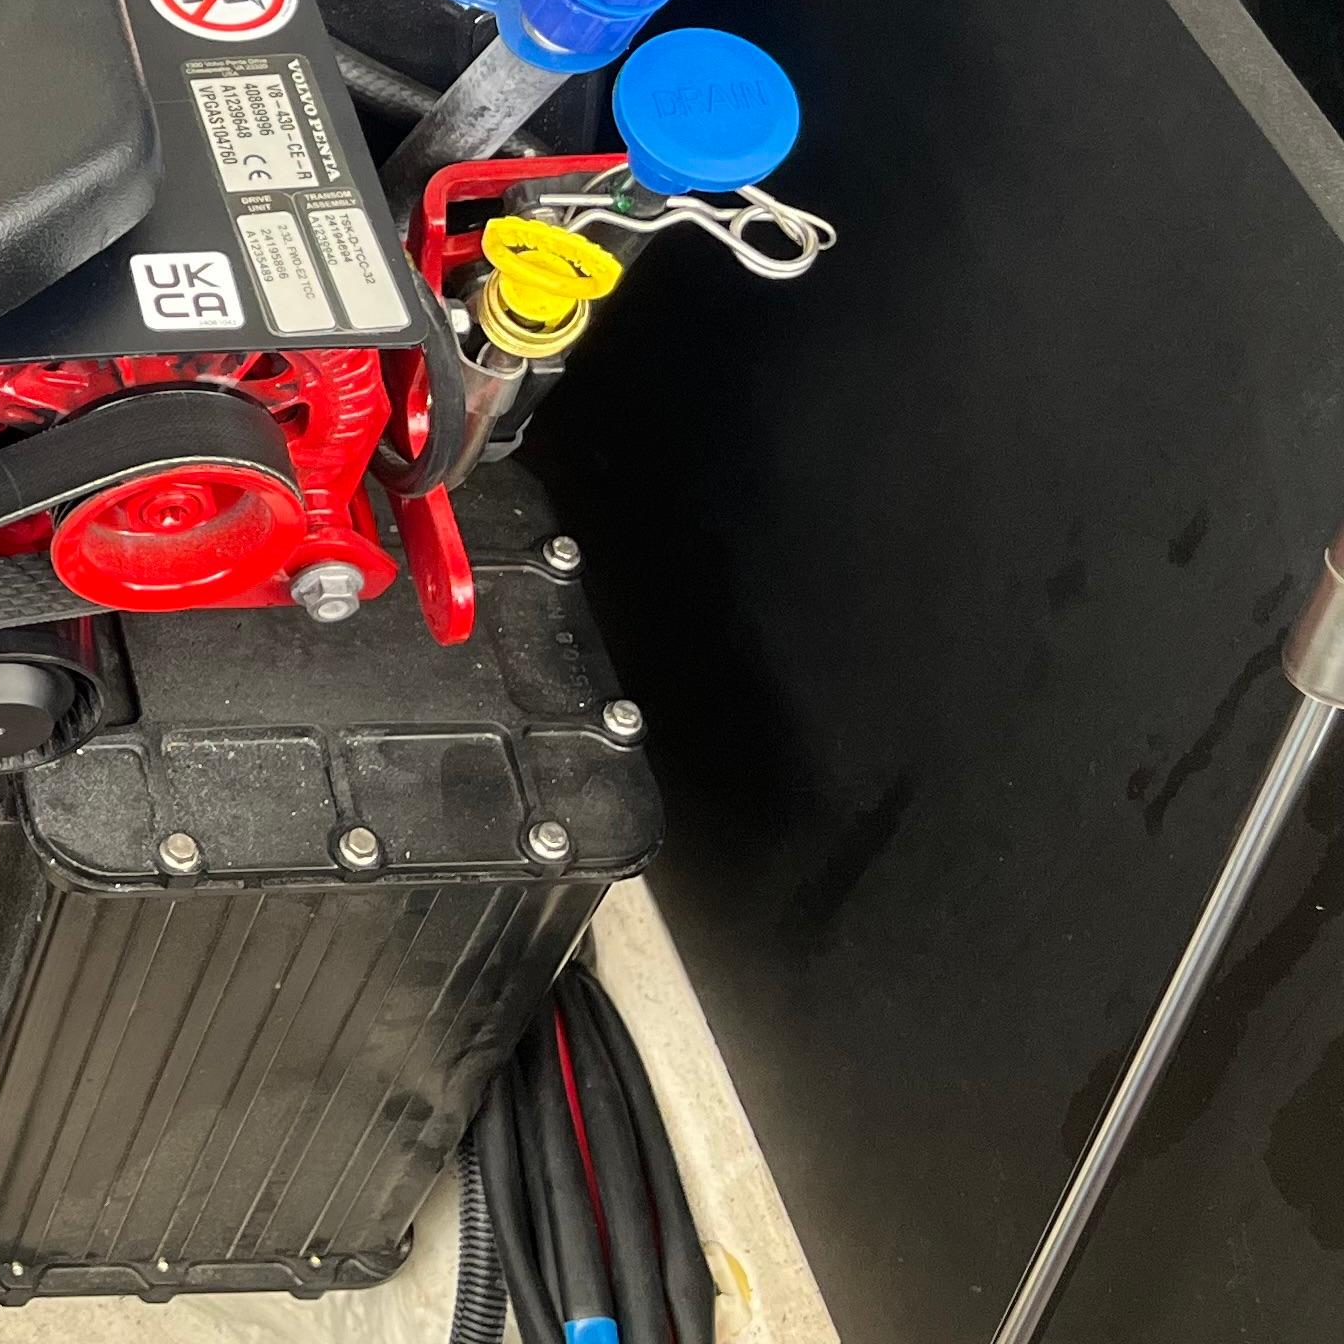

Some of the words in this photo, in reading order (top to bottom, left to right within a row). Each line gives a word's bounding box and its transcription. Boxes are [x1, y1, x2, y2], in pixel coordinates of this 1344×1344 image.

[220, 84, 253, 139] A1239648
[244, 83, 275, 137] 40869996
[652, 80, 769, 119] DRAIN
[198, 85, 239, 165] VPGAS104760
[288, 59, 317, 117] VOLVO
[308, 118, 341, 183] PENTA
[240, 195, 273, 205] DRIVE
[247, 203, 272, 213] UNIT
[304, 190, 352, 201] TRANSOM
[144, 262, 222, 288] UK
[154, 292, 229, 318] CA
